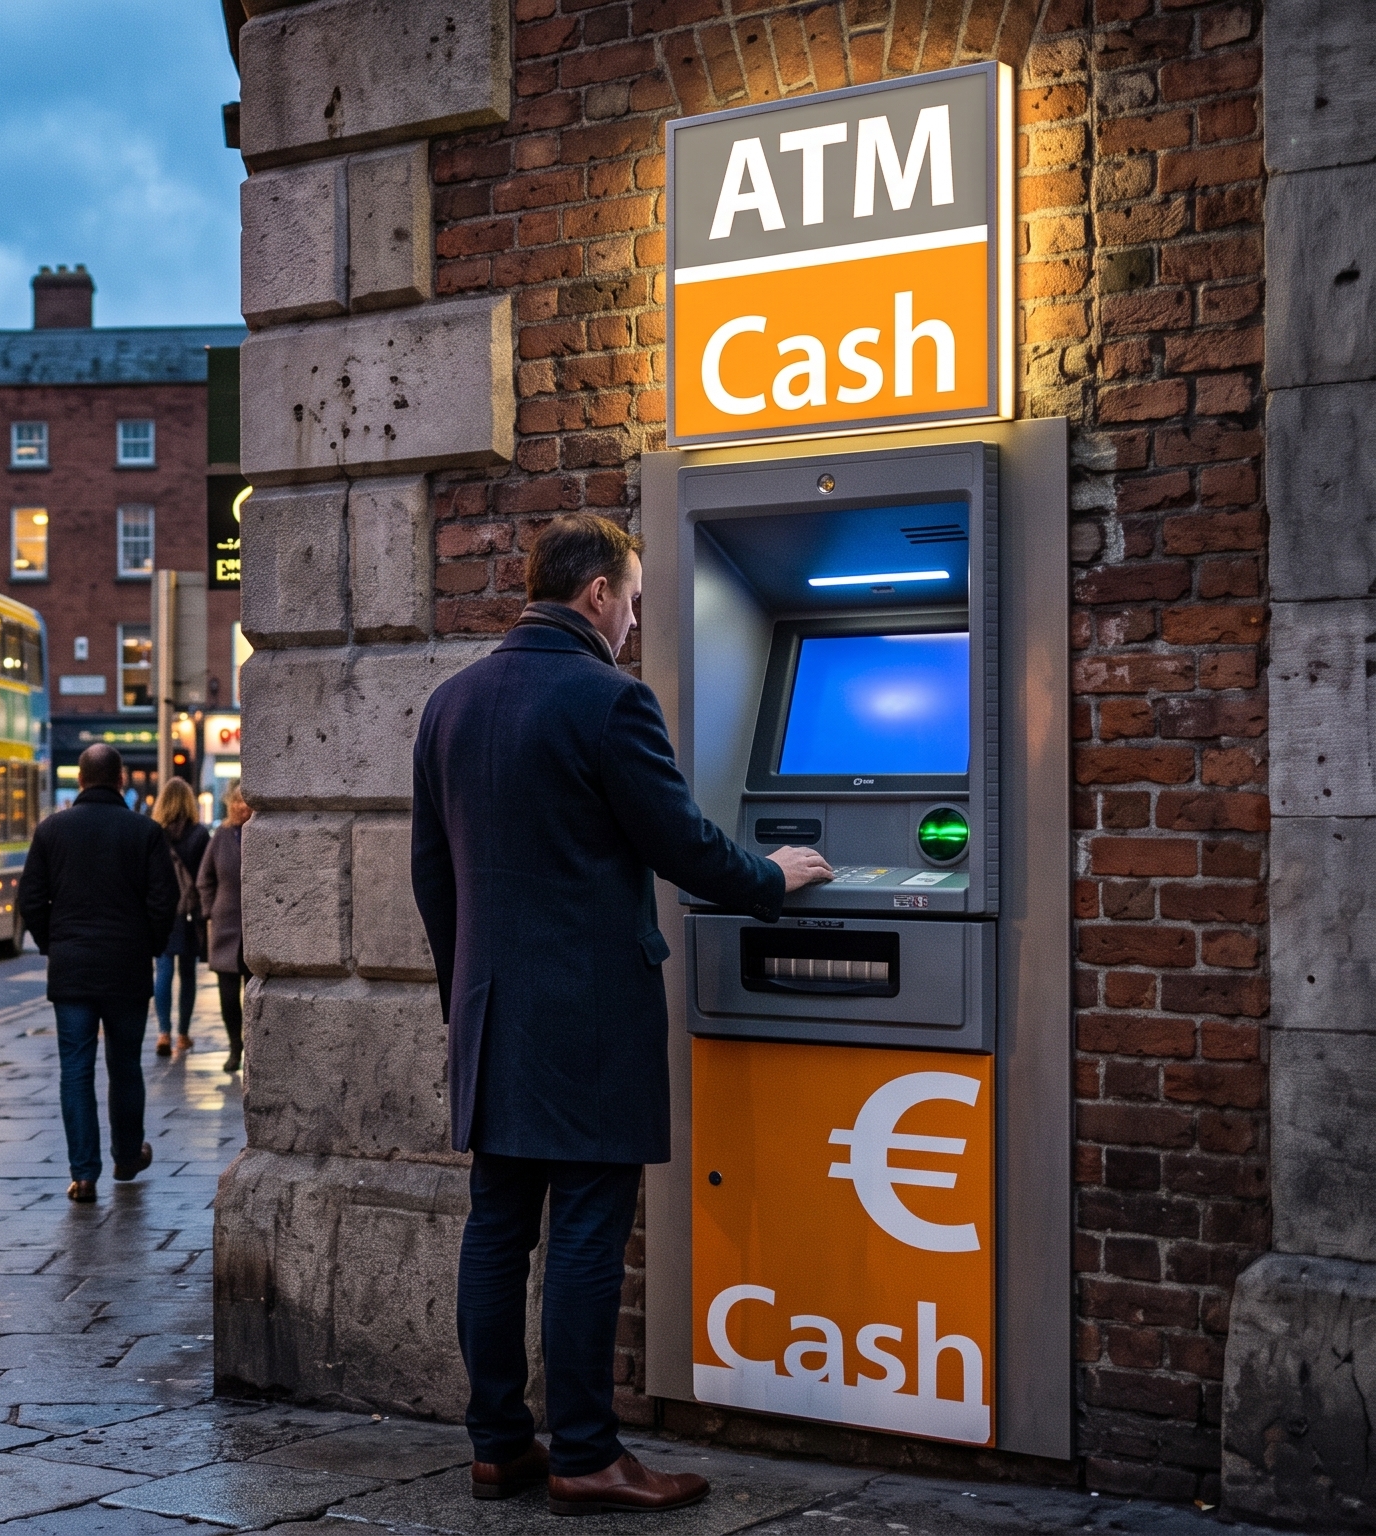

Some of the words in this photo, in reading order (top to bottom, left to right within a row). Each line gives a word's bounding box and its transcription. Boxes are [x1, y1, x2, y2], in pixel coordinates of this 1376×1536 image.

[708, 104, 955, 240] ATM
[701, 290, 956, 415] Cash
[827, 1071, 982, 1252] €
[707, 1284, 983, 1405] Cash
